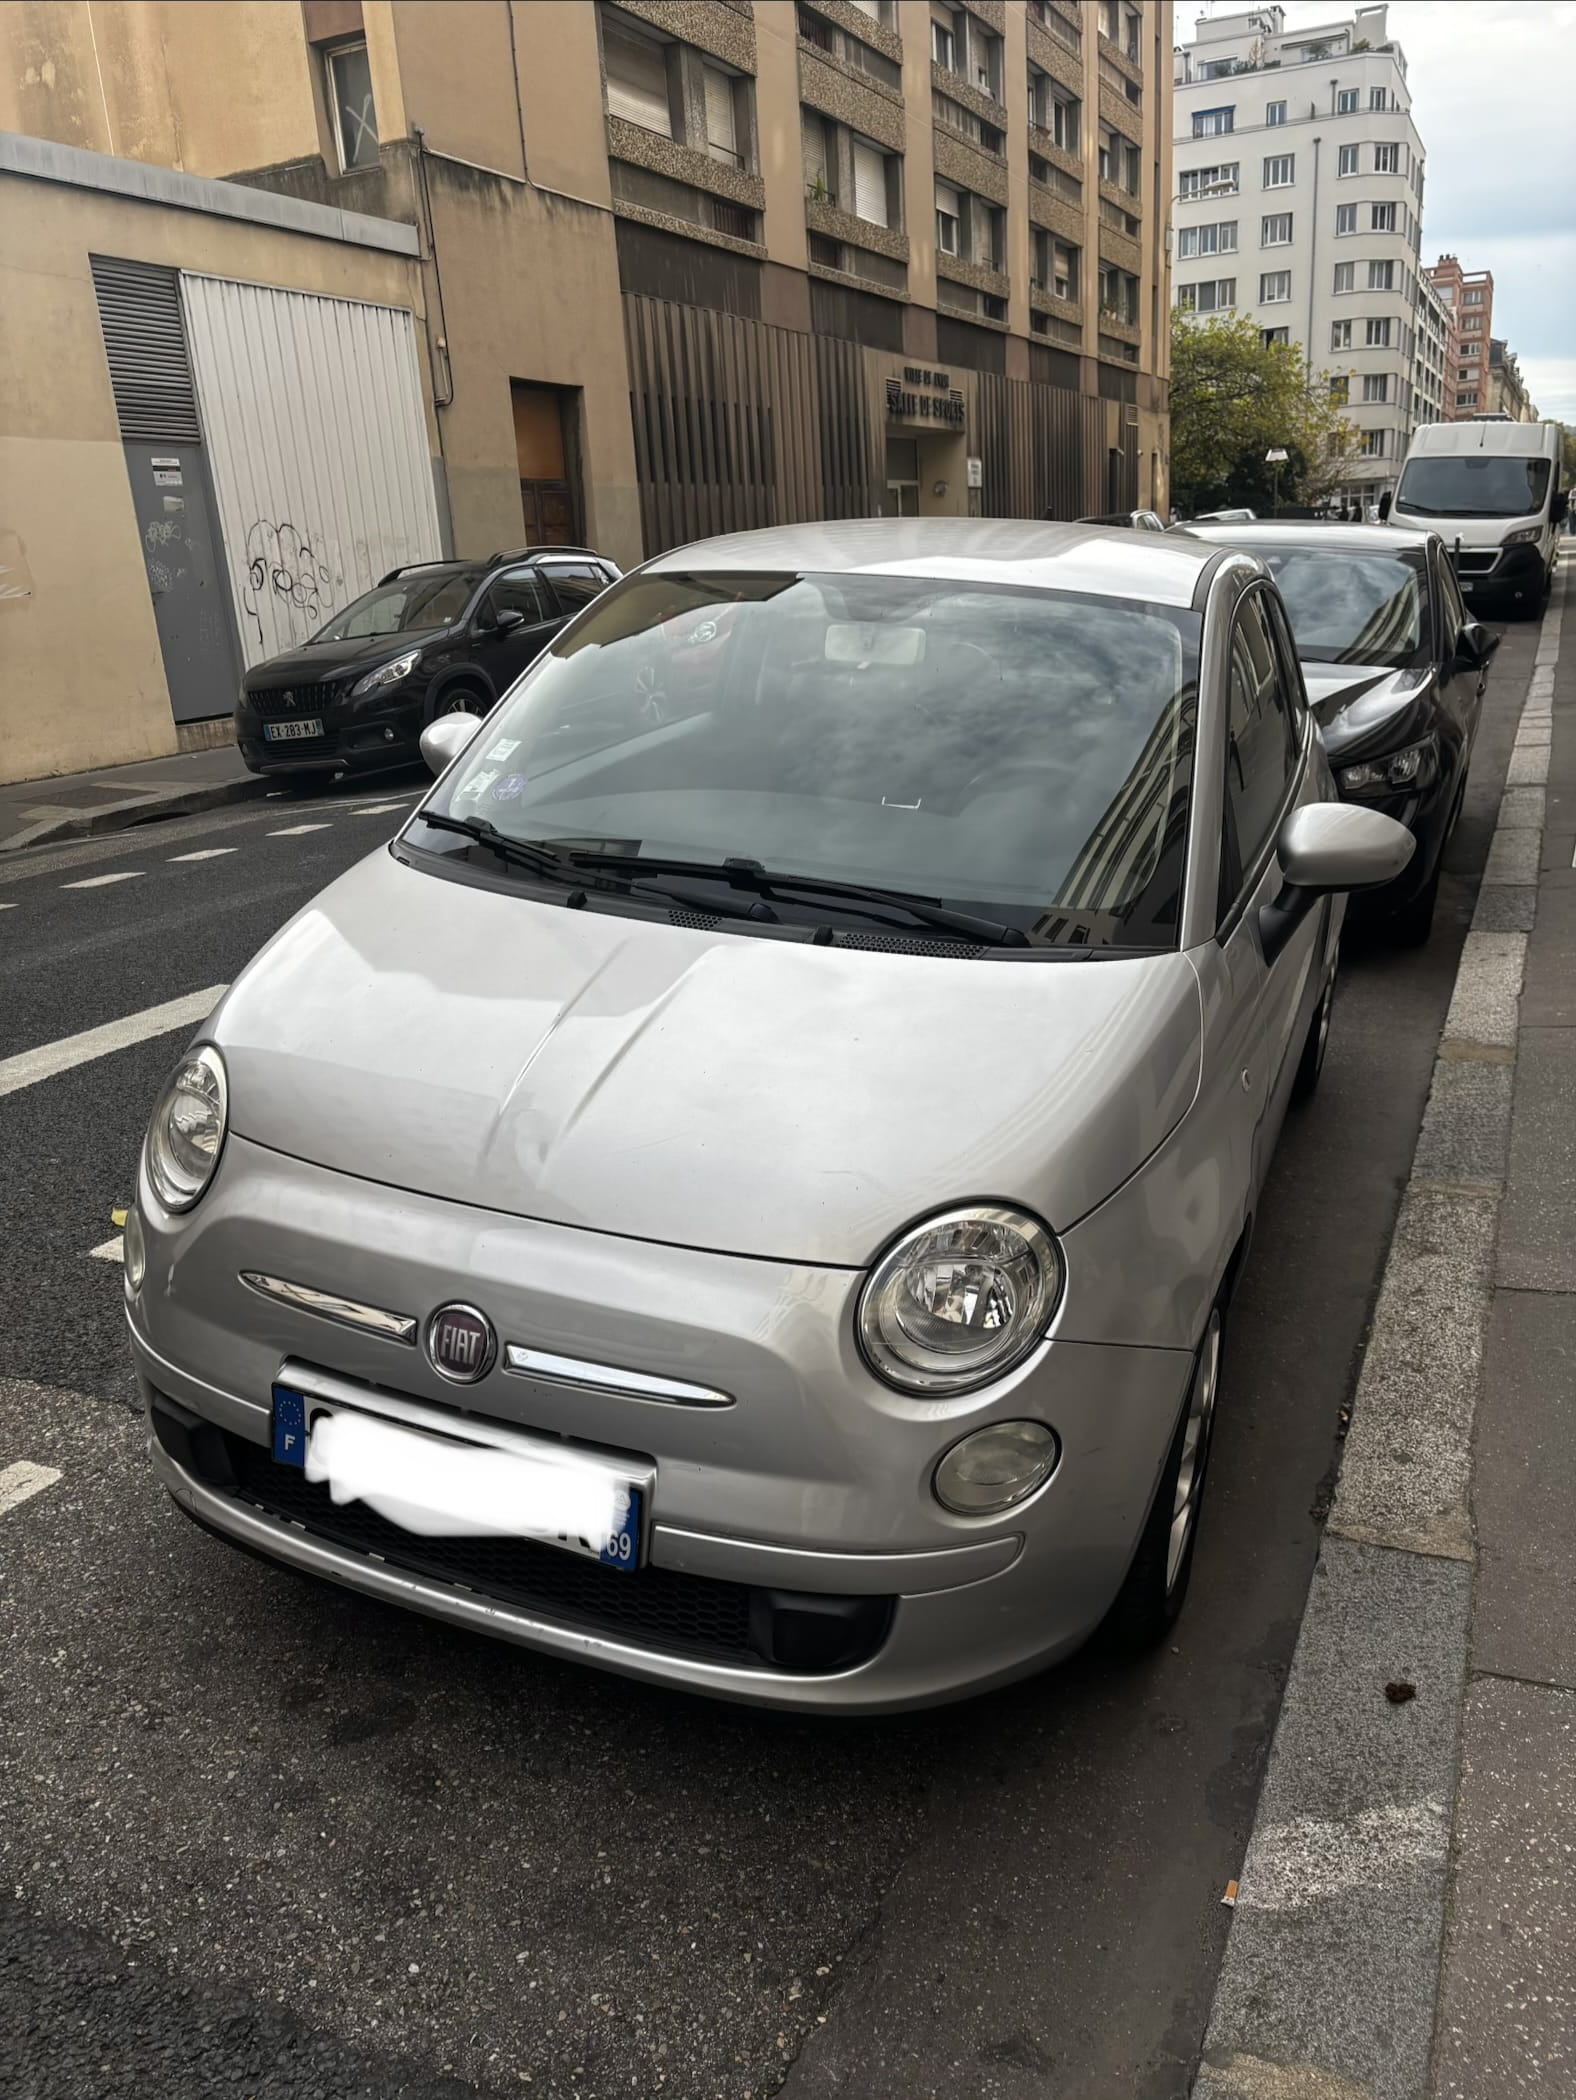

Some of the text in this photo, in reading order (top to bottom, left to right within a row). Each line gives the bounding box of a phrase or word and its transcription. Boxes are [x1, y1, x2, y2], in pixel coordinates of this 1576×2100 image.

[440, 1324, 481, 1365] FIAT
[284, 1433, 296, 1451] F
[606, 1529, 632, 1561] 69
